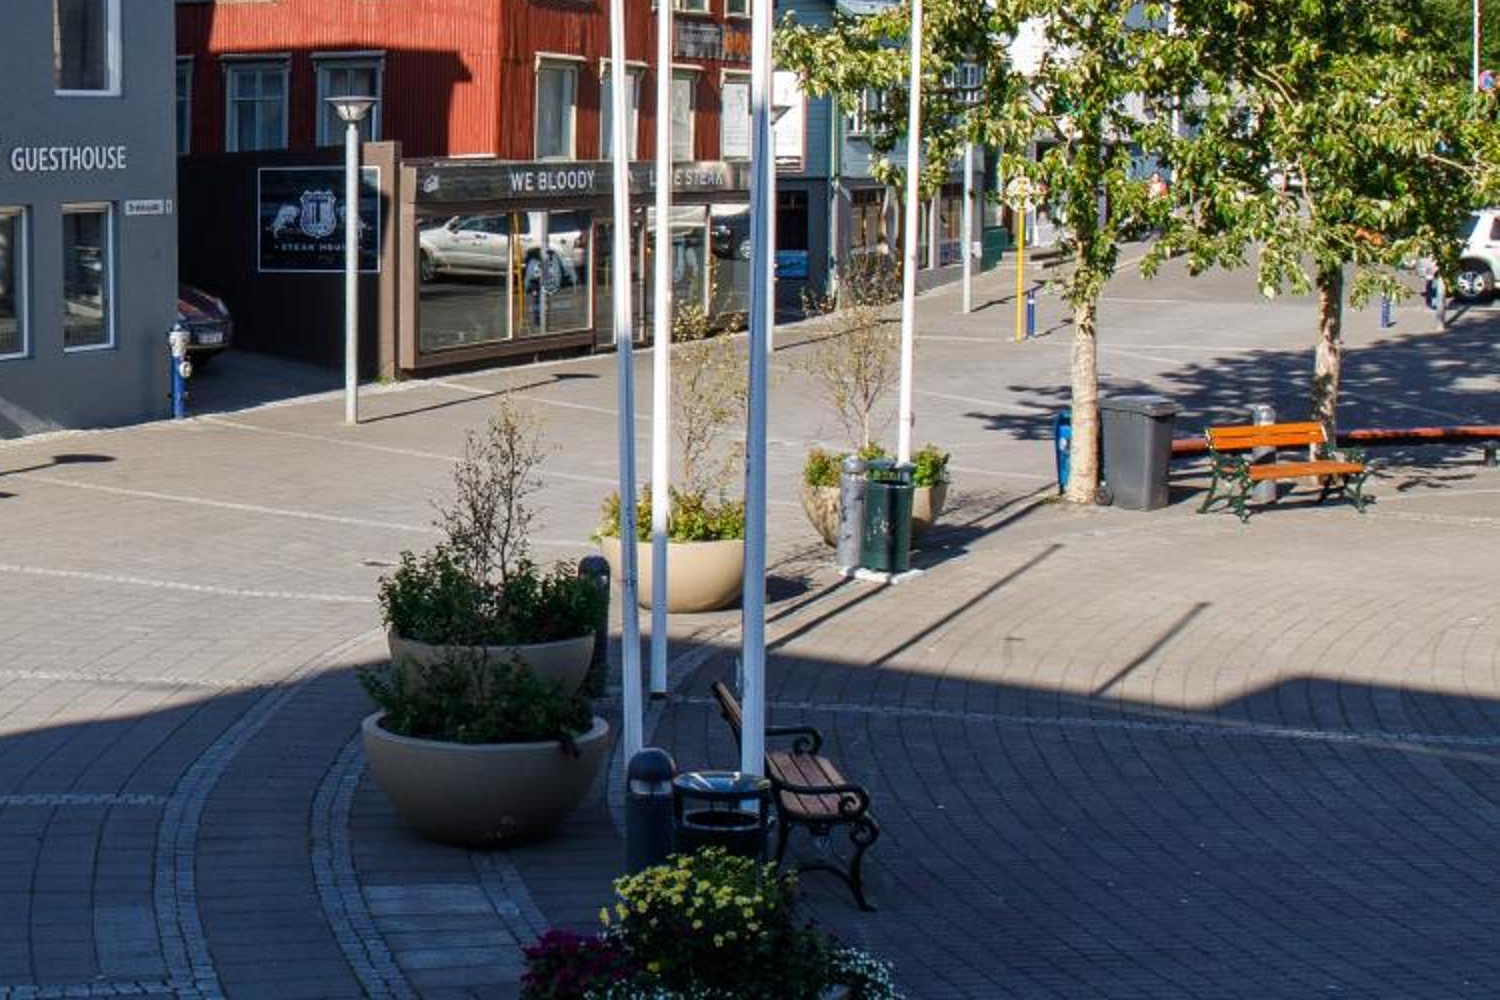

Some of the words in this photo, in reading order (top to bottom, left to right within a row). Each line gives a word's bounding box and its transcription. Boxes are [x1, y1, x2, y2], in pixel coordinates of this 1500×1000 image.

[11, 146, 127, 172] GUESTHOUSE
[510, 171, 534, 191] WE
[538, 169, 596, 191] BLOODY
[650, 169, 682, 186] LE
[685, 168, 724, 185] STEAK
[320, 243, 354, 251] HOU
